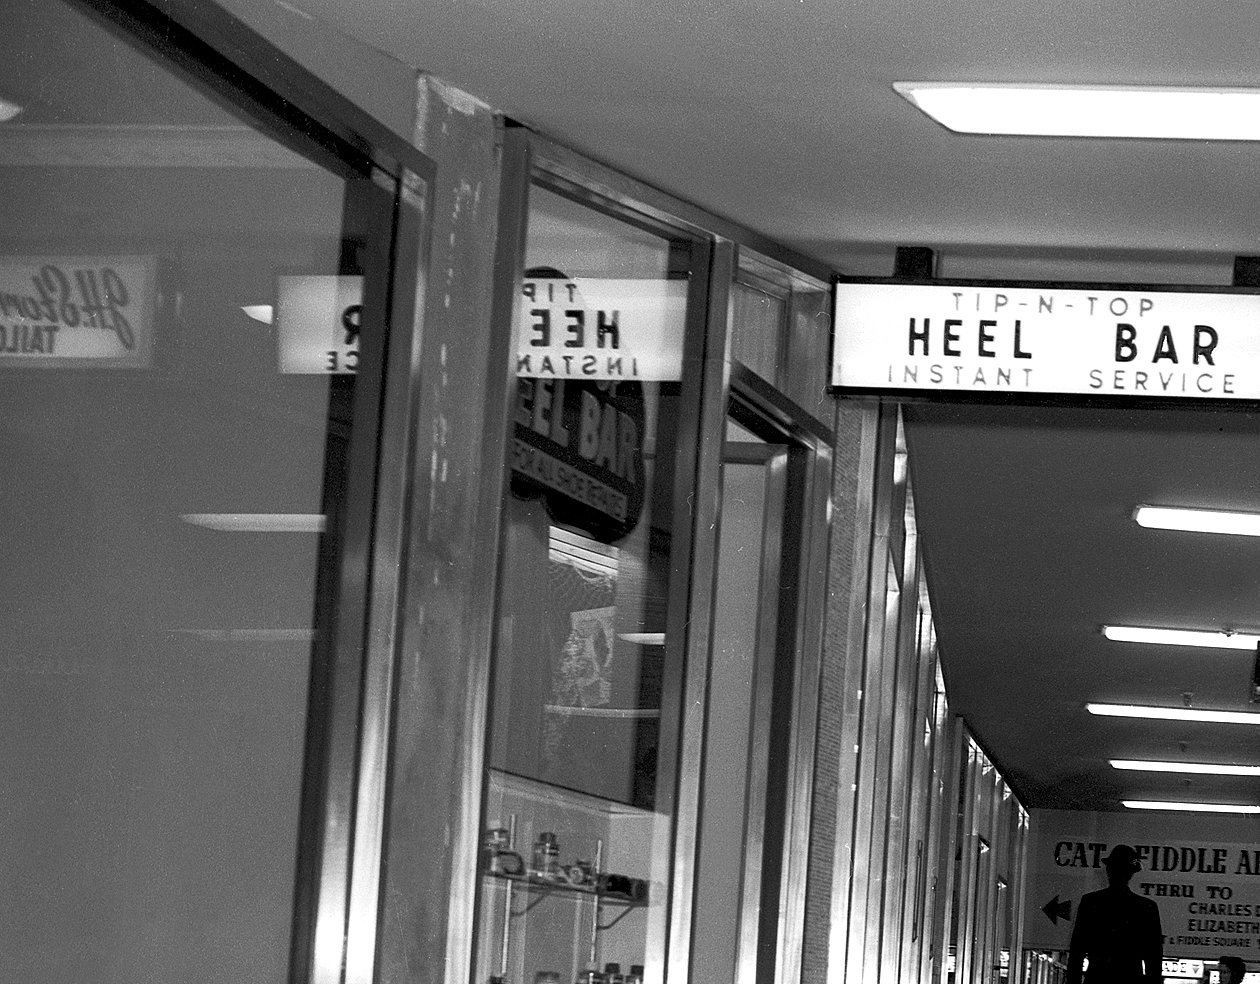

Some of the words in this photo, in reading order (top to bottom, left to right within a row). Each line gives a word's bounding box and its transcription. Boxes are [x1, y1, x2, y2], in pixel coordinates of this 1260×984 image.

[952, 292, 1155, 317] TIP-N-TOP
[907, 316, 1033, 360] HEEL
[1114, 322, 1219, 366] BAR
[887, 363, 1033, 388] INSTANT
[1088, 369, 1236, 394] SERVICE
[1053, 842, 1108, 869] CAT
[1140, 882, 1194, 898] THRU
[1205, 886, 1233, 900] TO
[1188, 902, 1253, 917] CHARLES
[1187, 918, 1260, 934] ELIZABETH
[1176, 935, 1211, 947] FIDDLE
[1213, 937, 1251, 948] SQUARE
